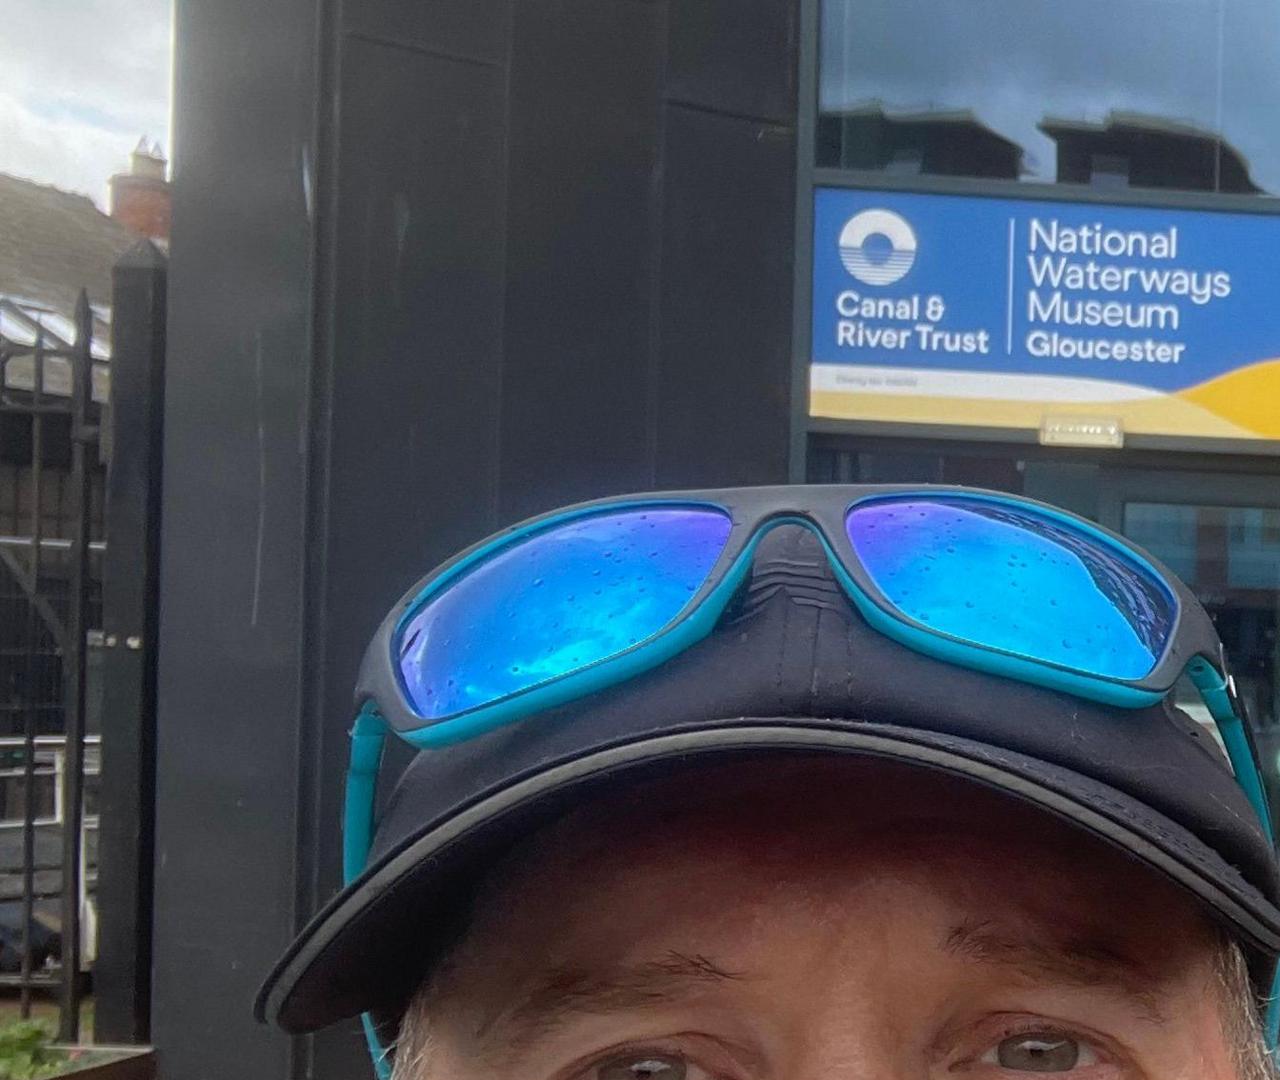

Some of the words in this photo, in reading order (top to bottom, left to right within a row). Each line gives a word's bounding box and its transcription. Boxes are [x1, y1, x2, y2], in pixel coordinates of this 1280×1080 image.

[1030, 218, 1177, 259] National
[1027, 253, 1231, 304] Waterways
[836, 290, 919, 320] Canal
[926, 294, 945, 321] &
[1028, 290, 1179, 330] Museum
[837, 320, 911, 349] River
[915, 324, 990, 353] Trust
[1026, 330, 1185, 364] Gloucester
